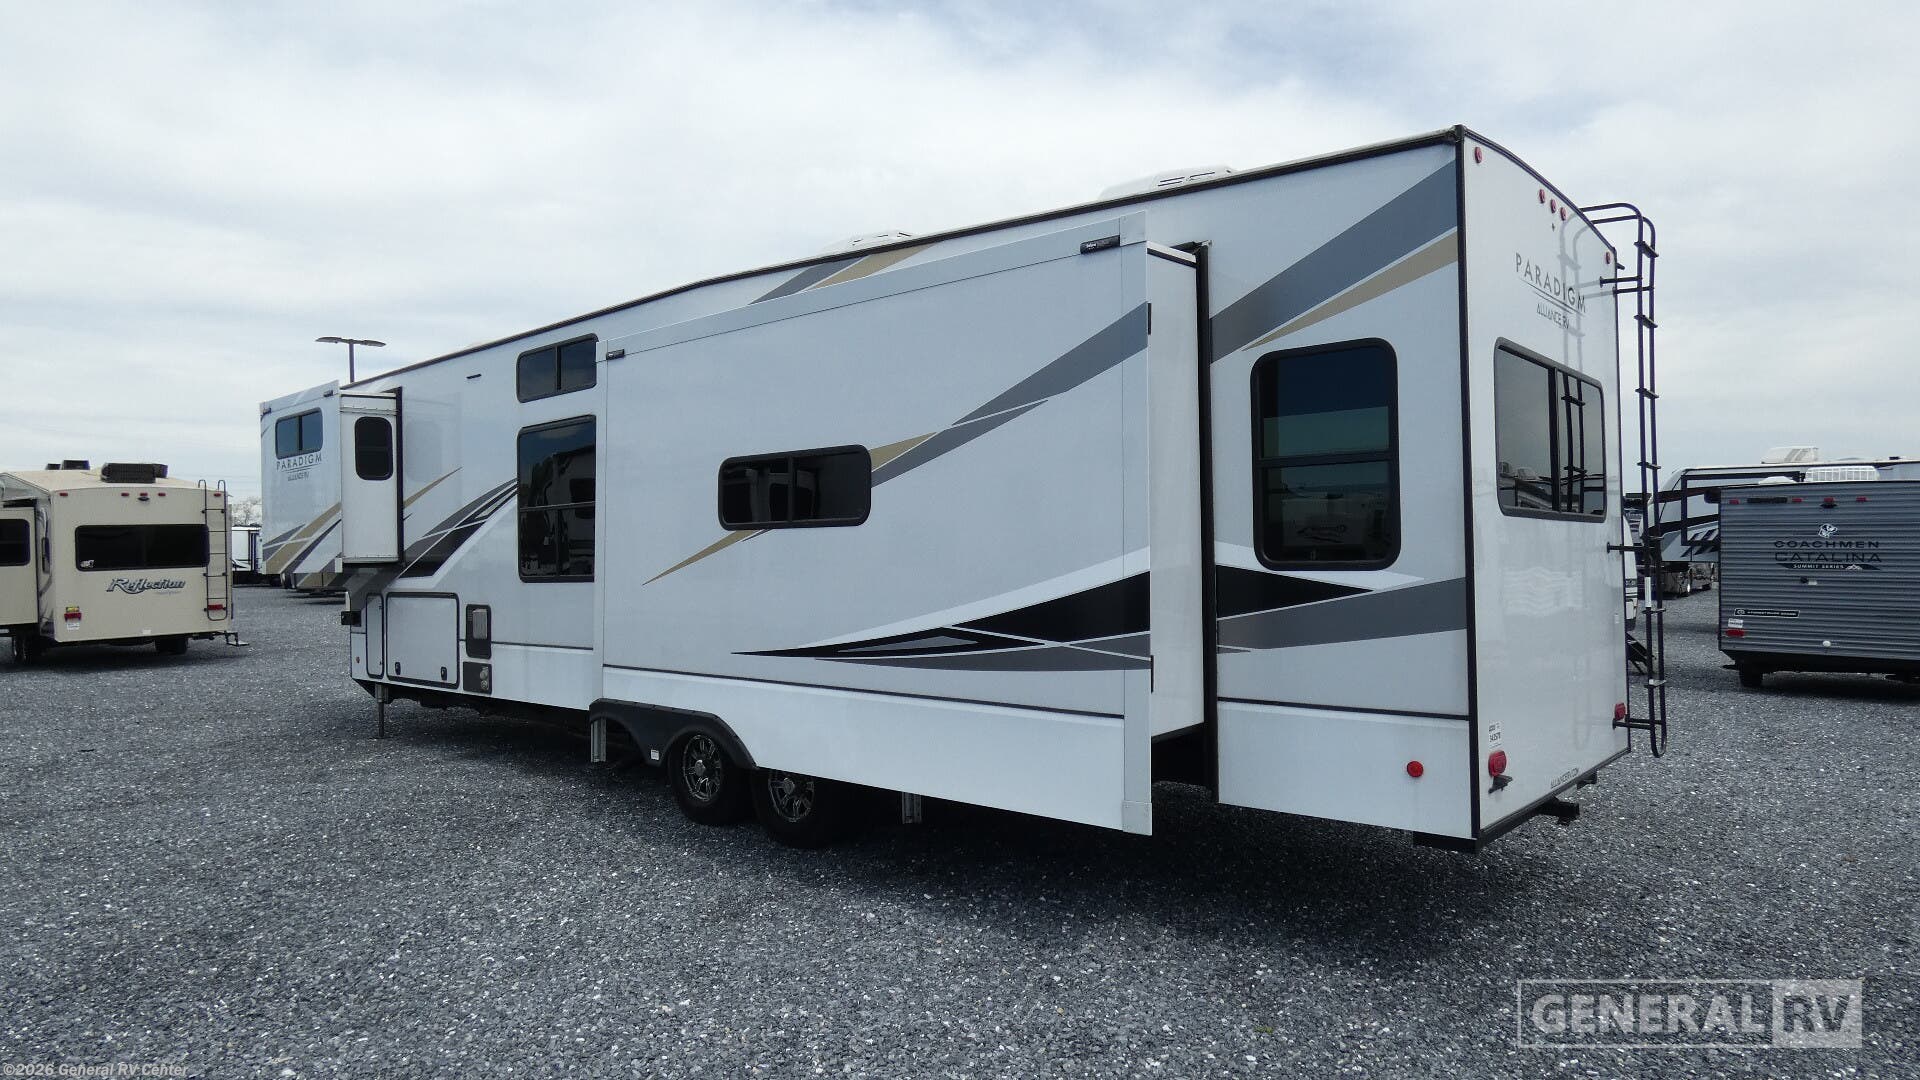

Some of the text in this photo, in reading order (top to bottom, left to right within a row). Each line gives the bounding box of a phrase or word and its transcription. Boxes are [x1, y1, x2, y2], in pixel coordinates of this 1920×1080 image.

[1515, 252, 1586, 313] PARADIGM
[276, 452, 322, 471] PARADIGM
[1774, 540, 1880, 548] COACHMEN
[1775, 552, 1882, 562] CATALINA
[106, 578, 186, 594] Reflection
